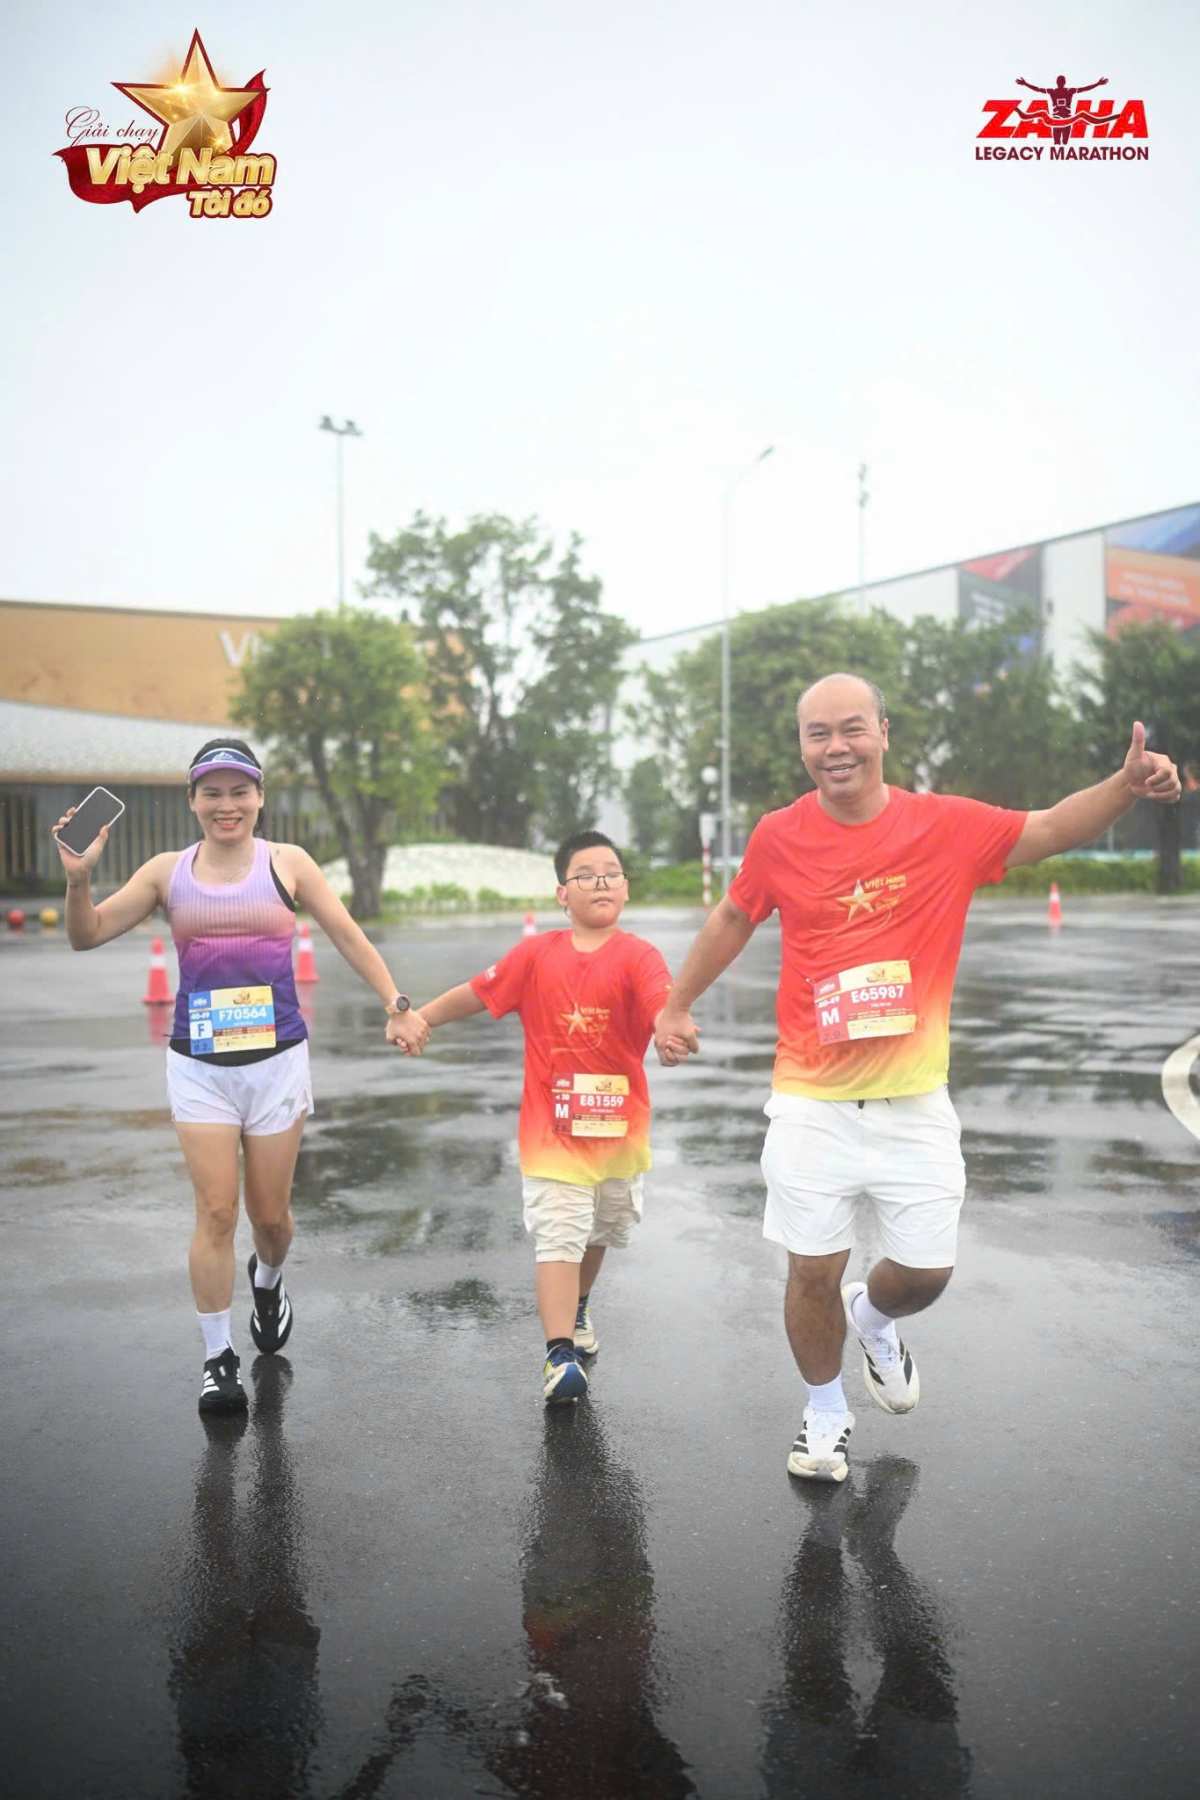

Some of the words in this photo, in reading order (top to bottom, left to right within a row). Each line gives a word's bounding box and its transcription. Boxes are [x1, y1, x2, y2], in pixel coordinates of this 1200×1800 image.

[850, 984, 905, 1004] E65987
[218, 1006, 267, 1022] F70564
[821, 1007, 840, 1027] M
[197, 1023, 205, 1037] F
[579, 1094, 624, 1108] E81559
[554, 1103, 570, 1119] M
